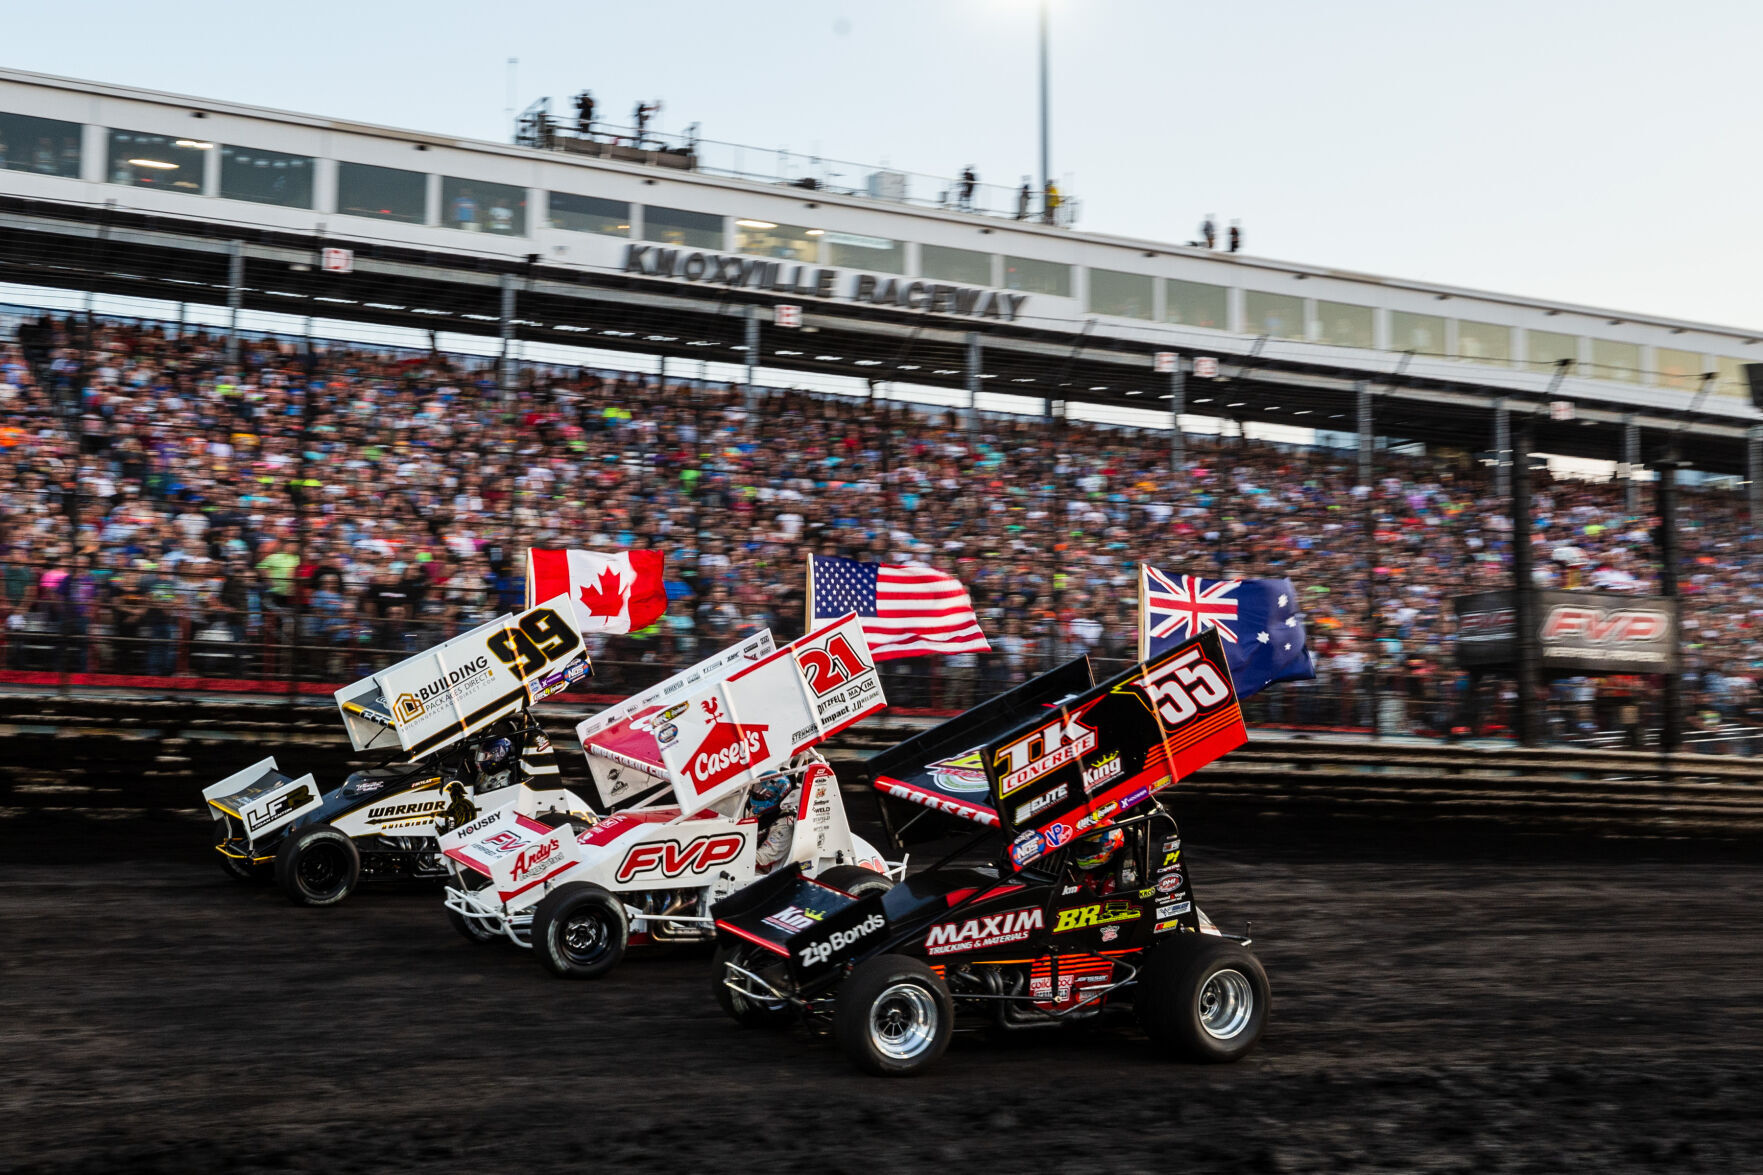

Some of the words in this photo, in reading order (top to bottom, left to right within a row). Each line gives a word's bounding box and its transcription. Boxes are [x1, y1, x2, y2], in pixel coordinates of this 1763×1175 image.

[626, 243, 837, 298] KNOXVILLE
[856, 273, 1029, 322] RACEWAY
[486, 608, 580, 682] 99
[418, 656, 488, 702] BUILDING
[464, 671, 488, 690] DIRECT
[797, 634, 871, 698] 21
[817, 692, 846, 716] DITZFELD
[848, 680, 876, 698] MAXIM
[1134, 649, 1230, 725] 55
[821, 705, 850, 725] Impact
[695, 730, 761, 782] Casey's
[998, 710, 1091, 773] TK
[1007, 736, 1092, 790] CONCRETE
[1083, 757, 1121, 788] King
[368, 801, 446, 818] WARRIOR
[1031, 783, 1068, 812] ELITE
[457, 811, 501, 839] HOUSBY
[1046, 823, 1063, 846] VP
[510, 838, 560, 882] Andy's
[617, 835, 743, 881] FVP
[925, 908, 1044, 947] MAXIM
[1053, 904, 1101, 933] BR
[929, 941, 973, 956] TRUCKING
[974, 939, 981, 948] &
[982, 930, 1029, 947] MATERIALS
